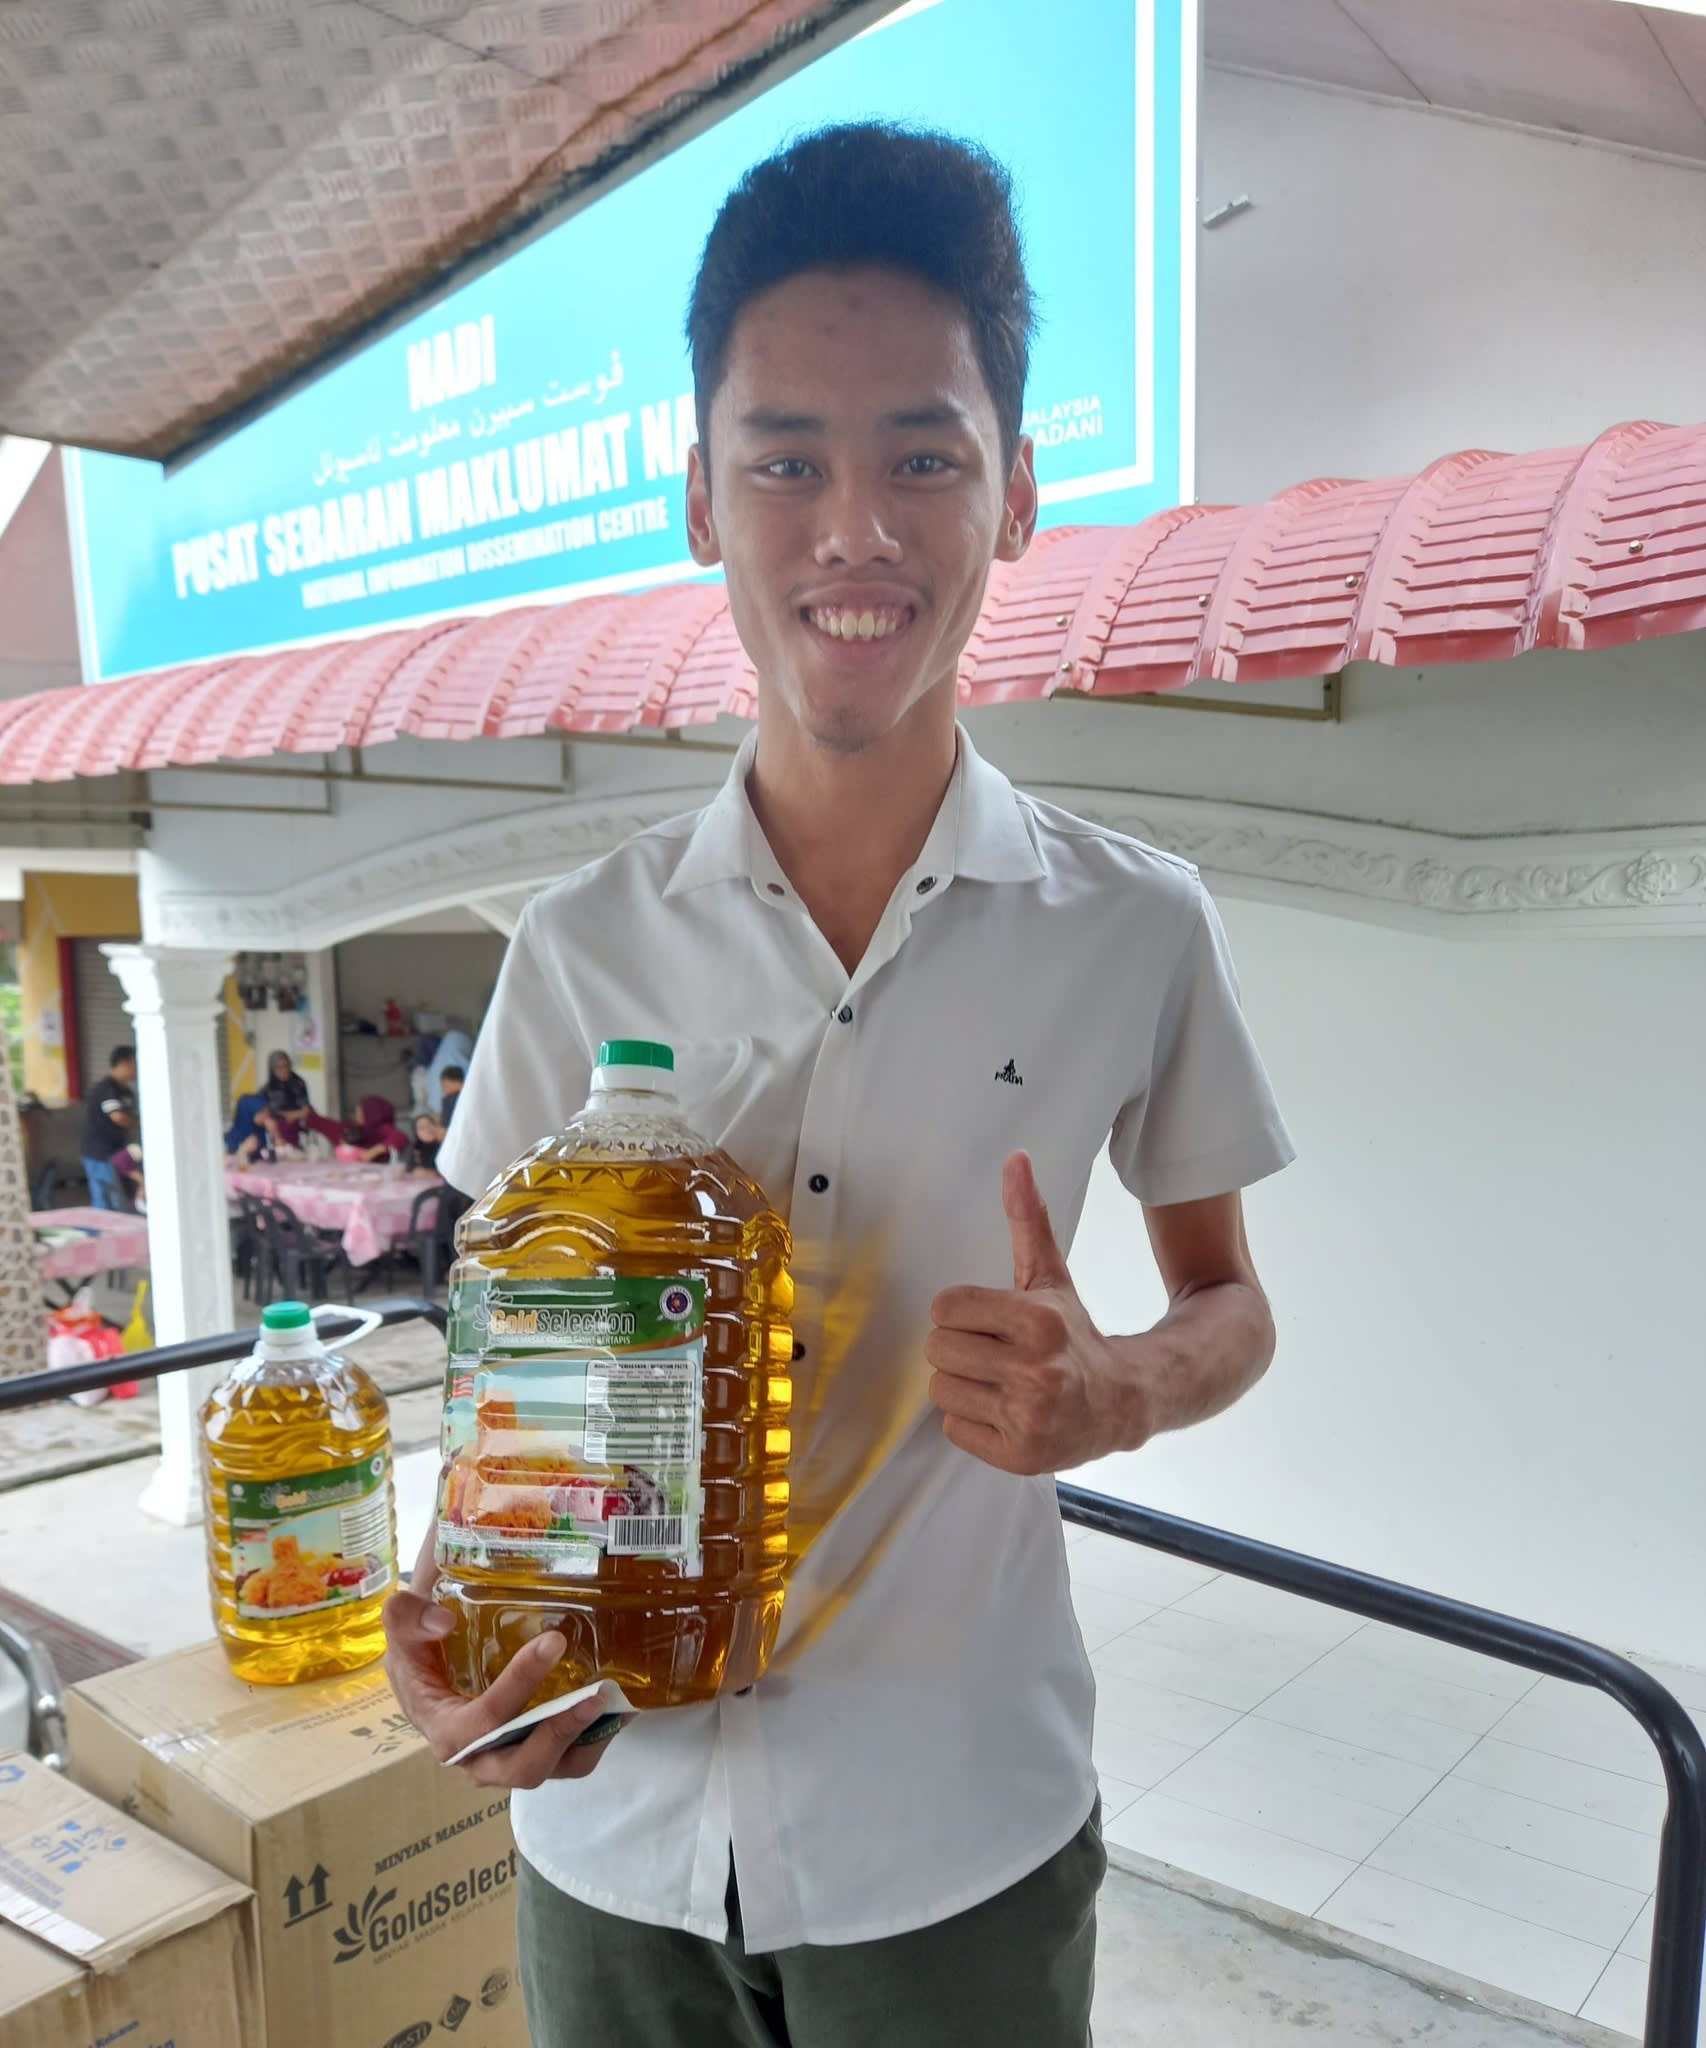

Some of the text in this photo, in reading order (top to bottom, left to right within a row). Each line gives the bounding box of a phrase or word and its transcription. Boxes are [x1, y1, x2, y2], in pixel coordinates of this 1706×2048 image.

[408, 314, 496, 411] NADI
[1034, 415, 1103, 447] ADANI
[171, 392, 699, 600] PUSAT SEBARAN MAKLUMAT NA
[597, 495, 671, 543] CENTRE
[490, 1307, 636, 1335] GoldSelection
[374, 1835, 432, 1876] MINYAK
[434, 1809, 484, 1844] MASAK
[369, 1848, 517, 1953] GoldSelect
